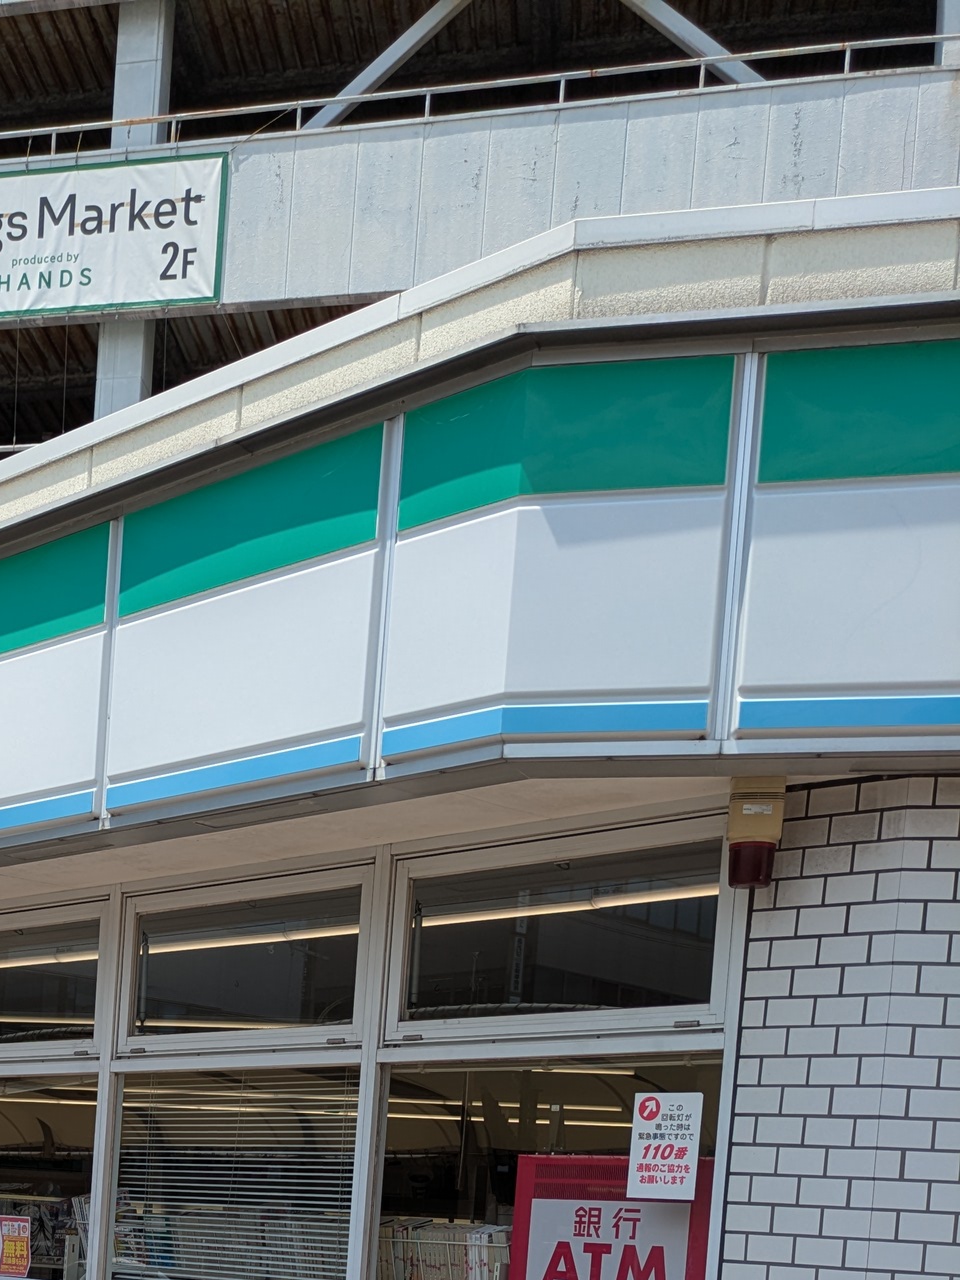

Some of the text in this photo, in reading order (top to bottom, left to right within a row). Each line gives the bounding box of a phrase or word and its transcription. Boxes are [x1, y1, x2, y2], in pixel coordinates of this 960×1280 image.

[37, 187, 204, 240] Market
[11, 252, 80, 269] produced by
[159, 241, 197, 281] 2F
[668, 1104, 684, 1112] この
[661, 1113, 692, 1122] 回転灯が
[655, 1123, 691, 1131] 鳴った時は
[638, 1132, 694, 1141] 緊急事態ですので
[642, 1143, 689, 1160] 110番
[636, 1163, 691, 1174] 通報のご協力を
[639, 1175, 687, 1185] お願いします
[572, 1206, 641, 1240] 銀行
[3, 1240, 28, 1258] 無料
